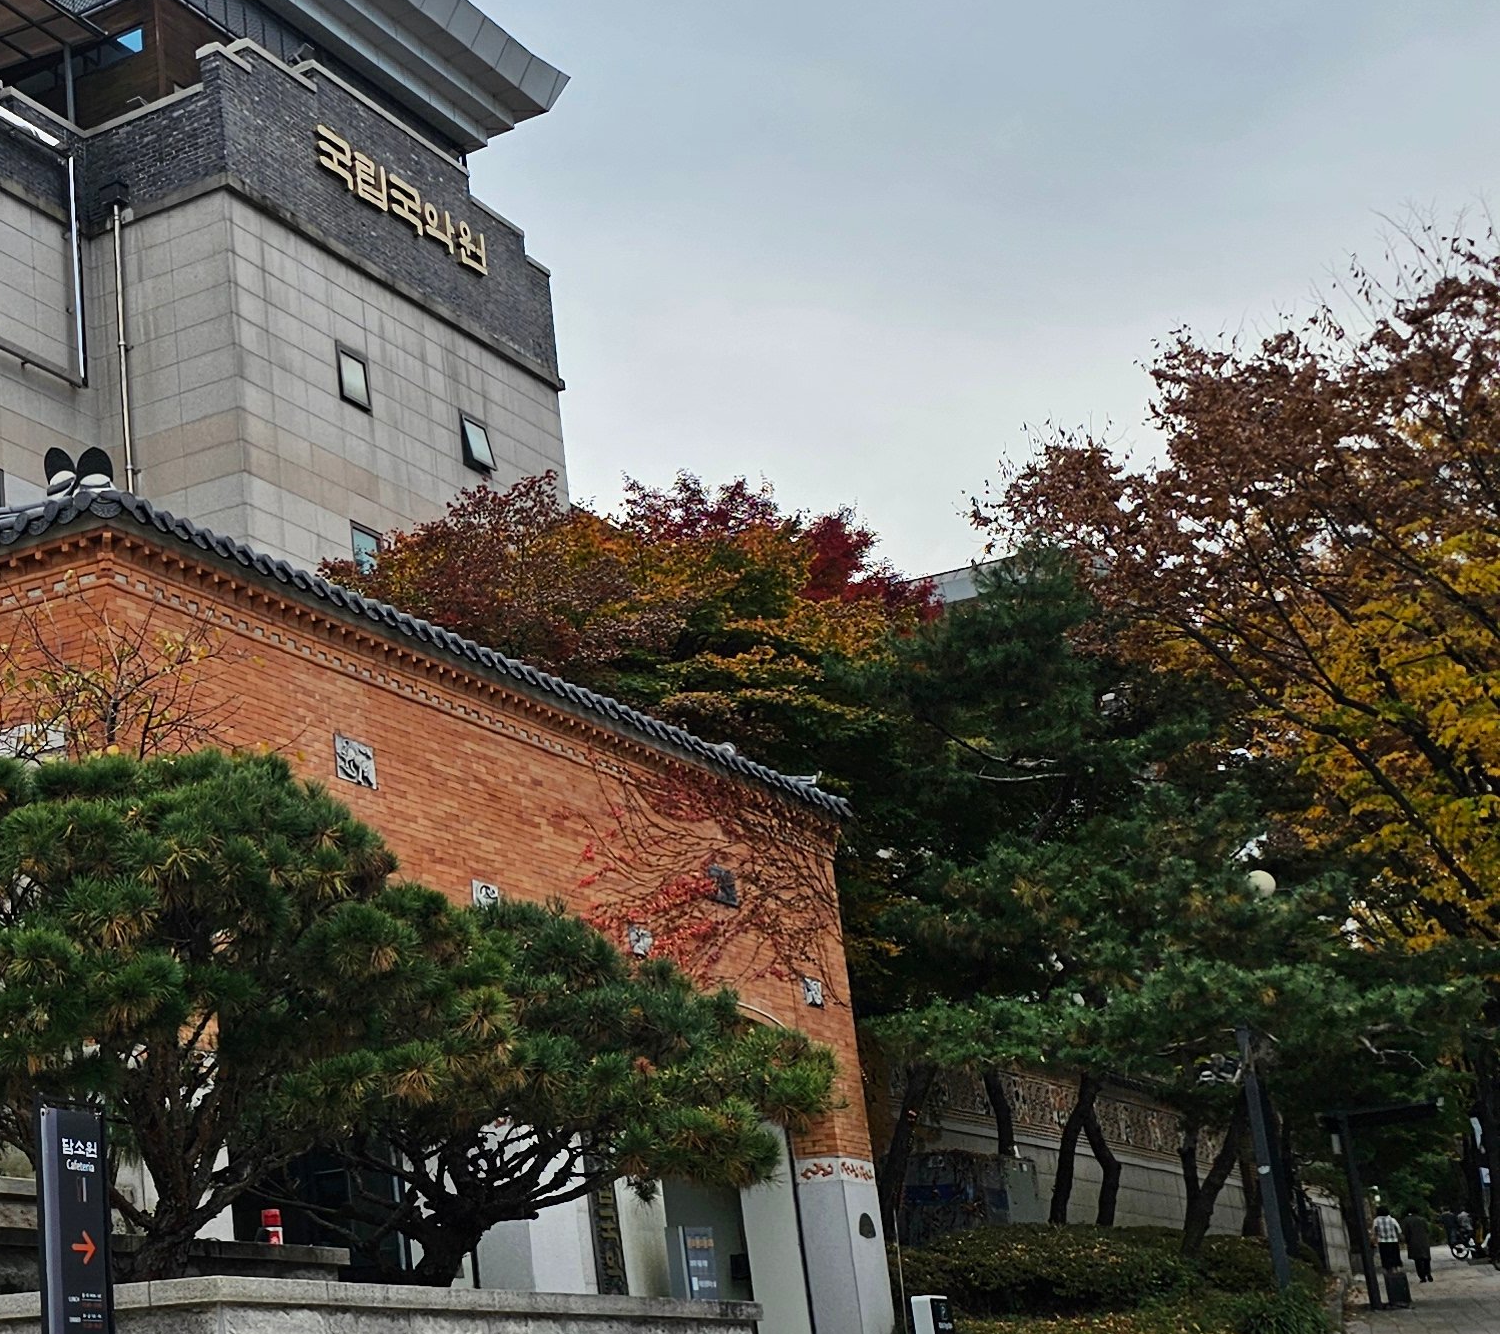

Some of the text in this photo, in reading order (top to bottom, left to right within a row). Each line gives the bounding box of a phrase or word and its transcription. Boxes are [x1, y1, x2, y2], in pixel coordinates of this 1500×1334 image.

[317, 123, 488, 277] 국립국악원
[62, 1137, 98, 1159] 담소원
[66, 1159, 95, 1173] Cafeteria
